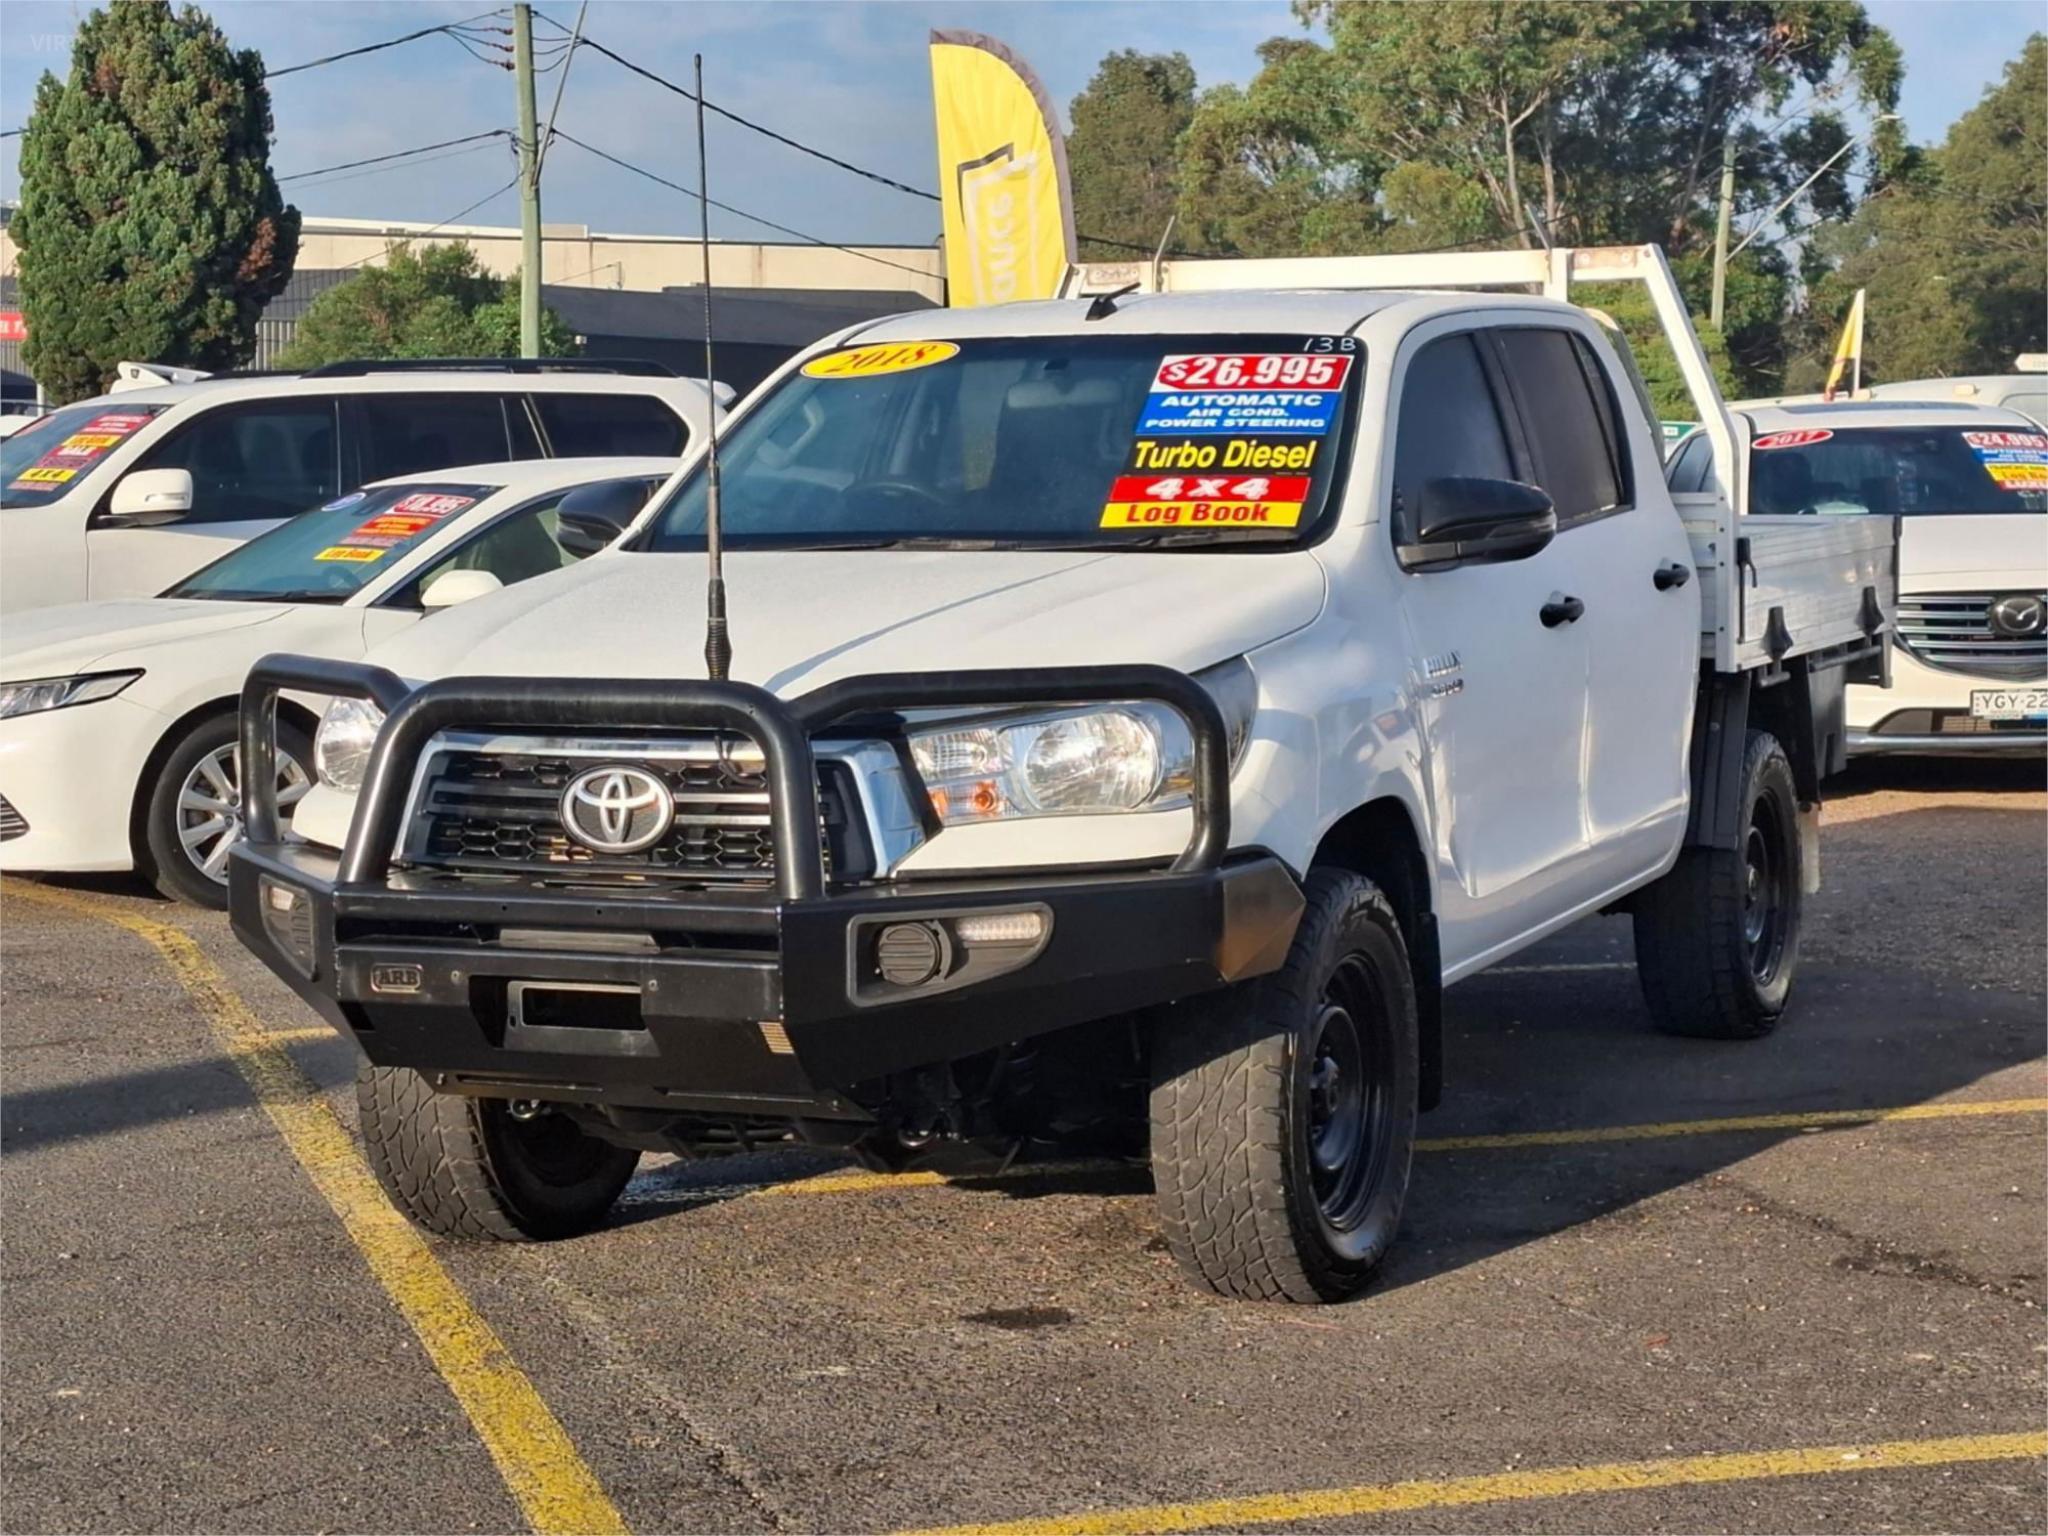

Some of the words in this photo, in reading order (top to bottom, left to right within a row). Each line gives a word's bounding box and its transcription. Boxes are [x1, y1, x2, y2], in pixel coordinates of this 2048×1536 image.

[1165, 356, 1338, 386] $26,995
[1161, 394, 1322, 407] AUTOMATIC
[1186, 408, 1224, 417] AIR
[1145, 418, 1216, 428] POWER
[1222, 418, 1325, 428] STEERING
[1135, 440, 1216, 469] Turbo
[1222, 440, 1317, 468] Diesel
[1126, 504, 1180, 523] Log
[1191, 503, 1270, 522] Book
[378, 969, 418, 985] ARB
